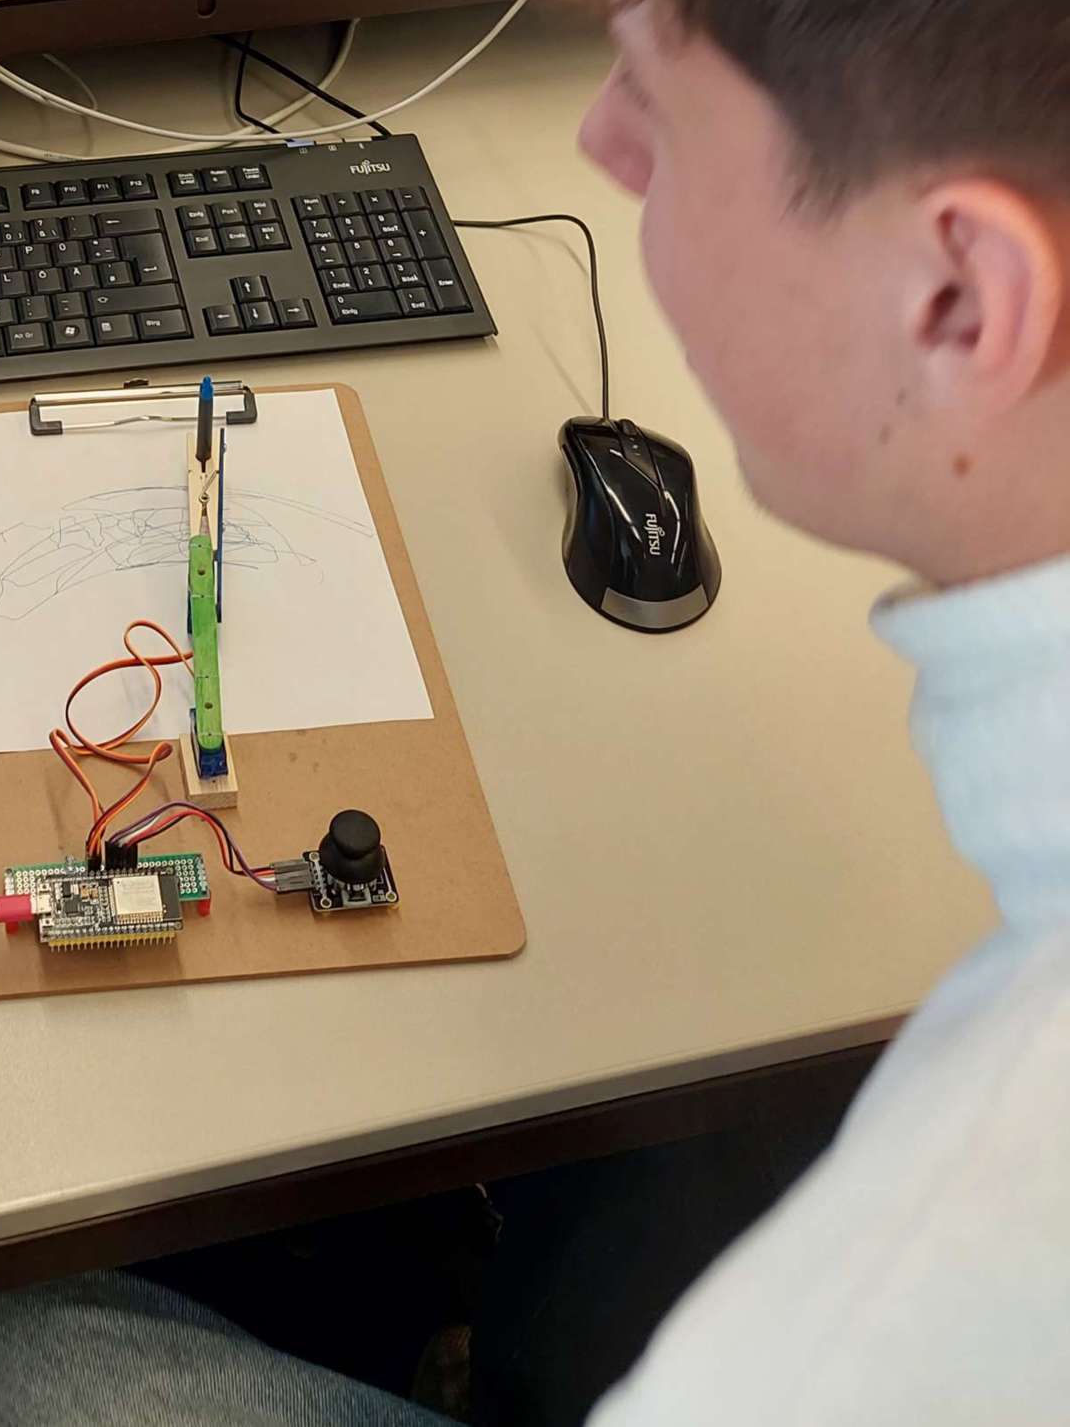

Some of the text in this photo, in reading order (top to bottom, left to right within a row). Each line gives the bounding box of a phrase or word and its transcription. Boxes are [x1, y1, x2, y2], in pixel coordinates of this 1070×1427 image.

[350, 160, 391, 174] FUJITSU
[25, 246, 33, 255] P
[3, 274, 12, 282] L
[645, 513, 665, 556] FUJITSU
